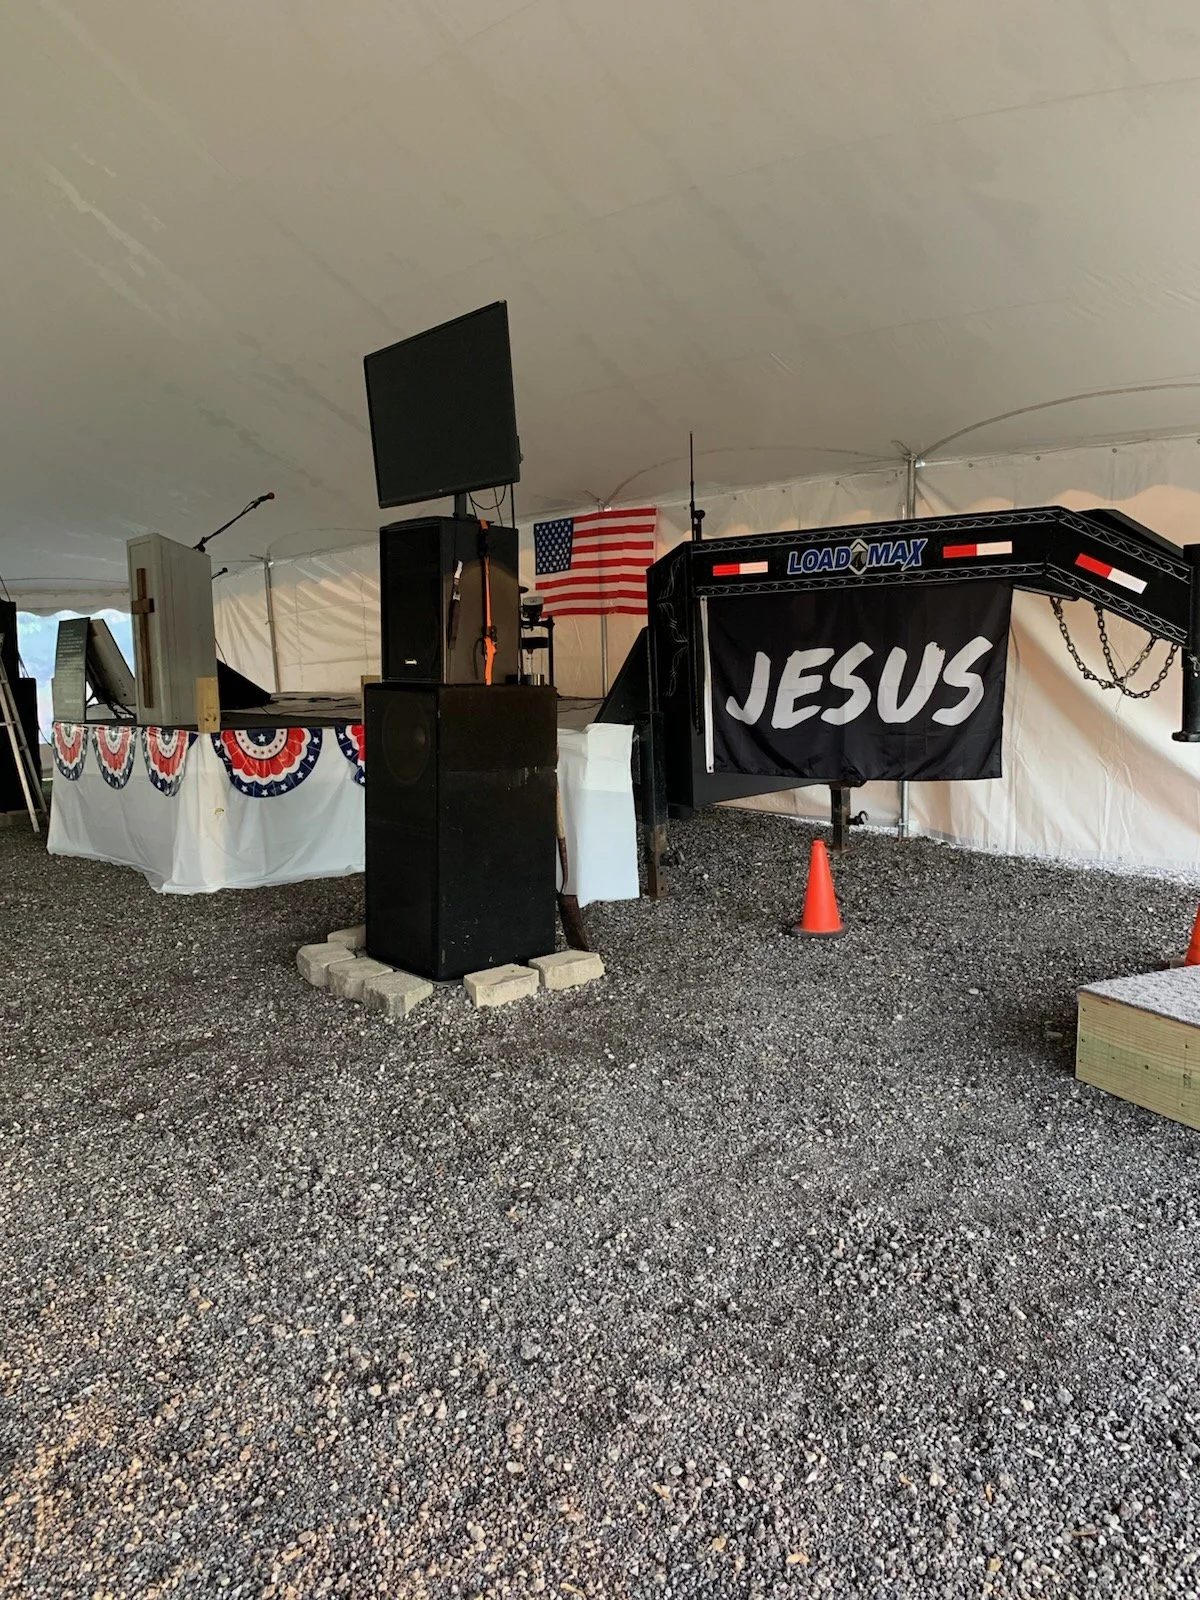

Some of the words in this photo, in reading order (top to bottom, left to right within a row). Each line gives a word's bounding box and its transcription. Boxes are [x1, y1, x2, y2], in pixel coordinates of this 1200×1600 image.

[787, 546, 853, 575] LOAD
[866, 538, 928, 571] MAX
[725, 635, 994, 730] JESUS
